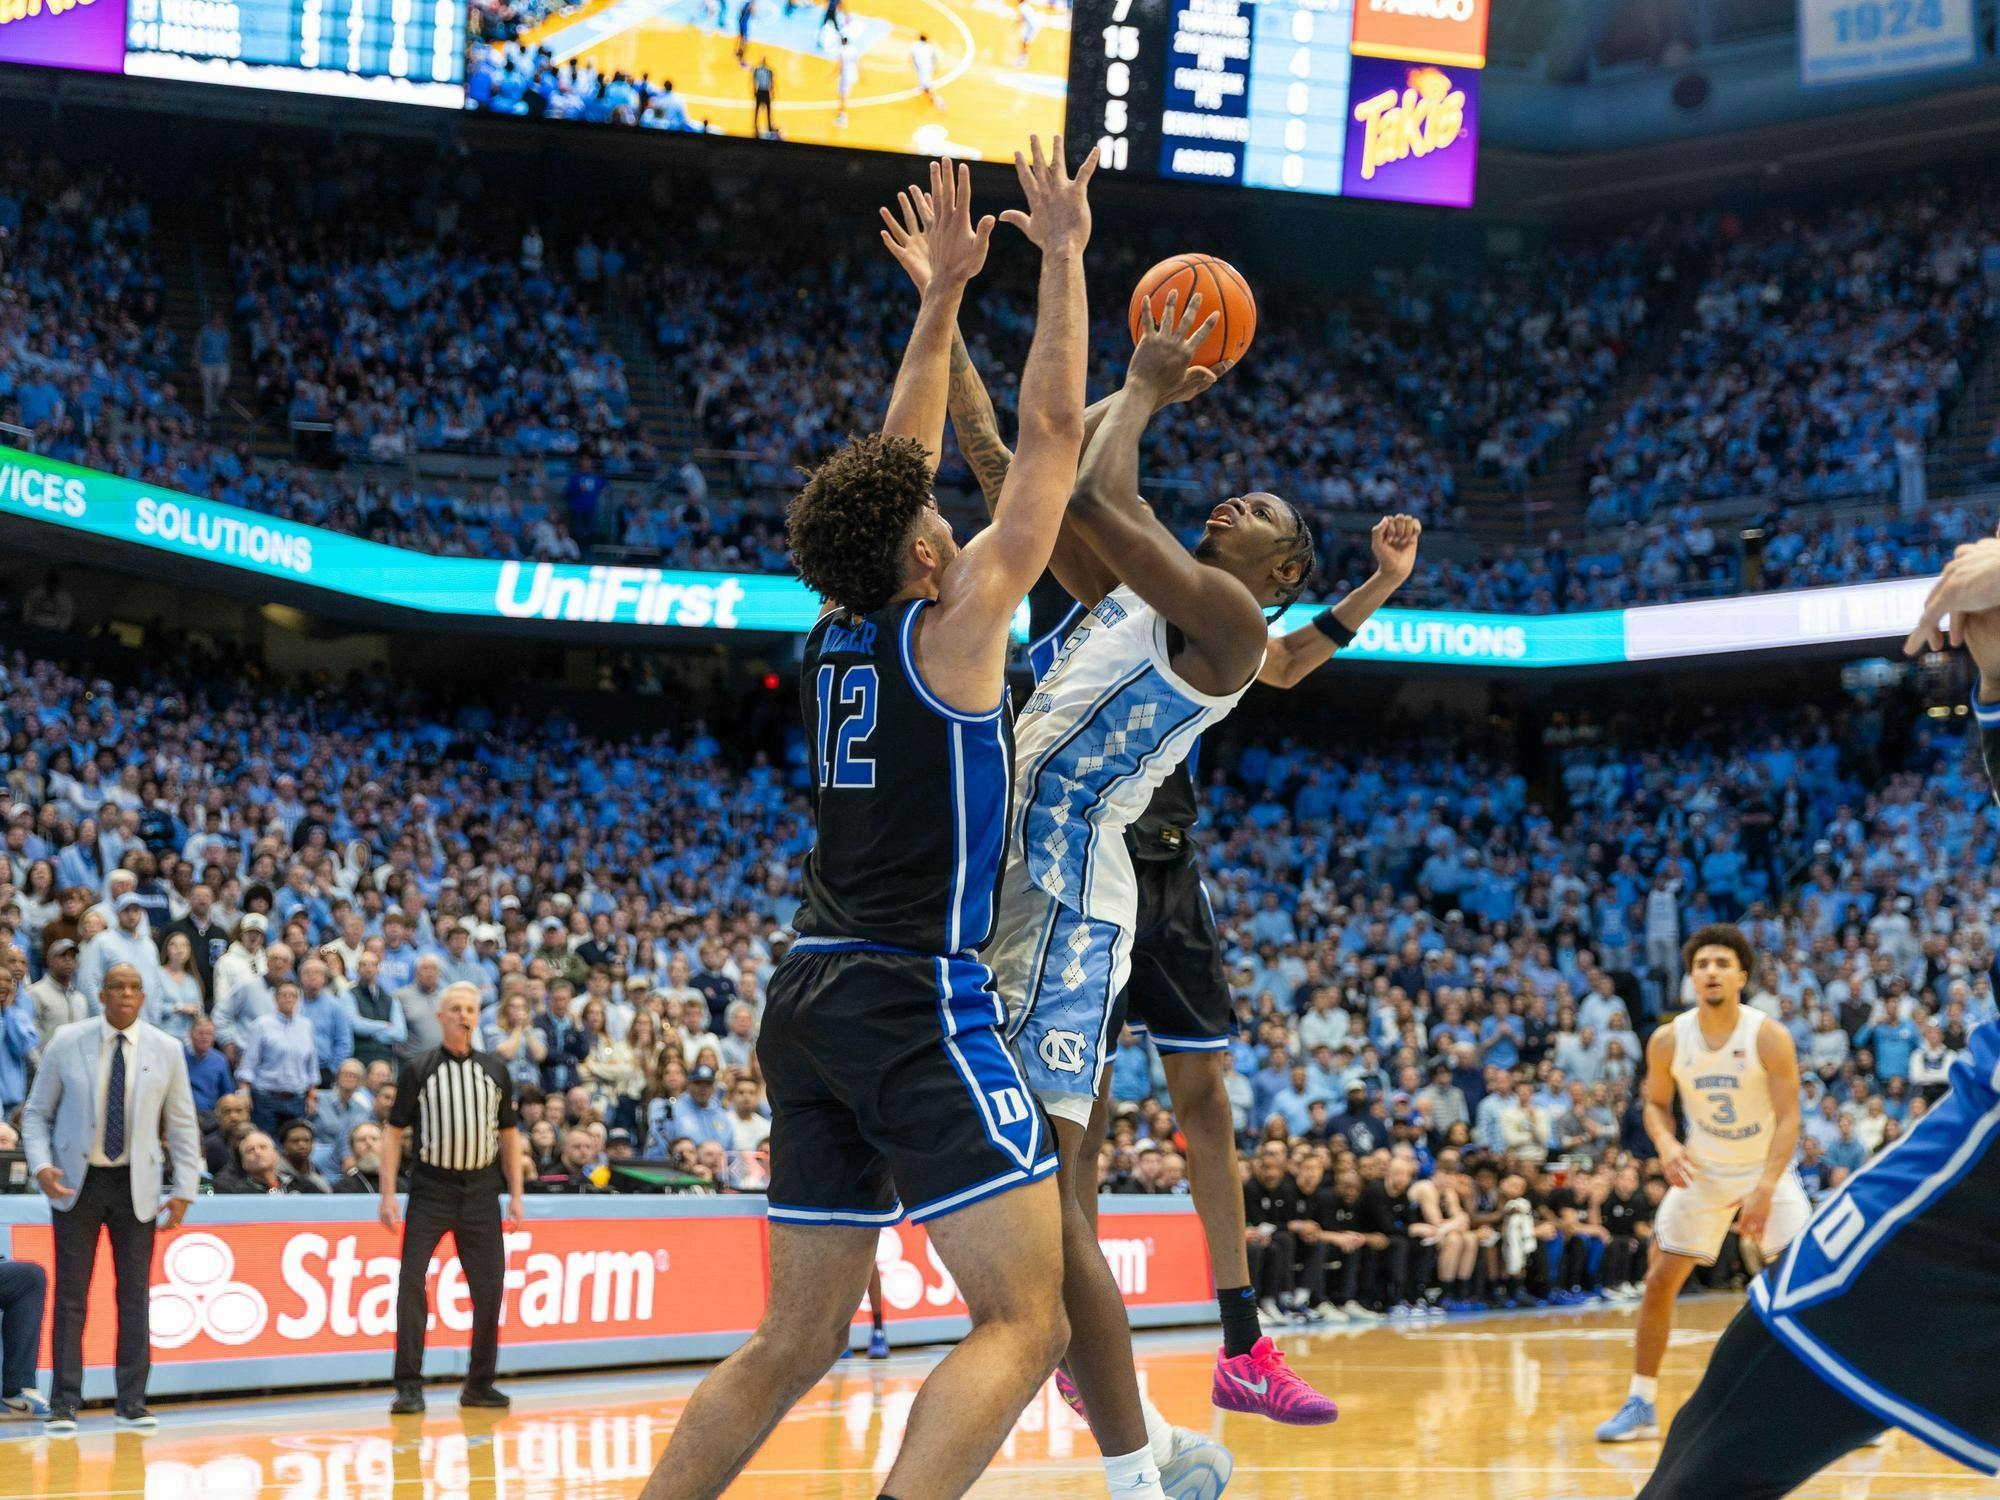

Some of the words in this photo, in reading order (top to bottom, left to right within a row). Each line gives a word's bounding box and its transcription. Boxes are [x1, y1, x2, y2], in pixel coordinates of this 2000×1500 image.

[1102, 25, 1139, 61] 15
[1832, 0, 1944, 43] 1924
[1104, 99, 1128, 134] 5
[1097, 135, 1128, 171] 11
[135, 497, 312, 573] SOLUTIONS
[495, 559, 745, 629] UniFirst
[816, 664, 879, 788] 12
[1707, 1093, 1736, 1124] 3
[276, 1232, 475, 1340] Stae
[498, 1231, 655, 1328] Farm
